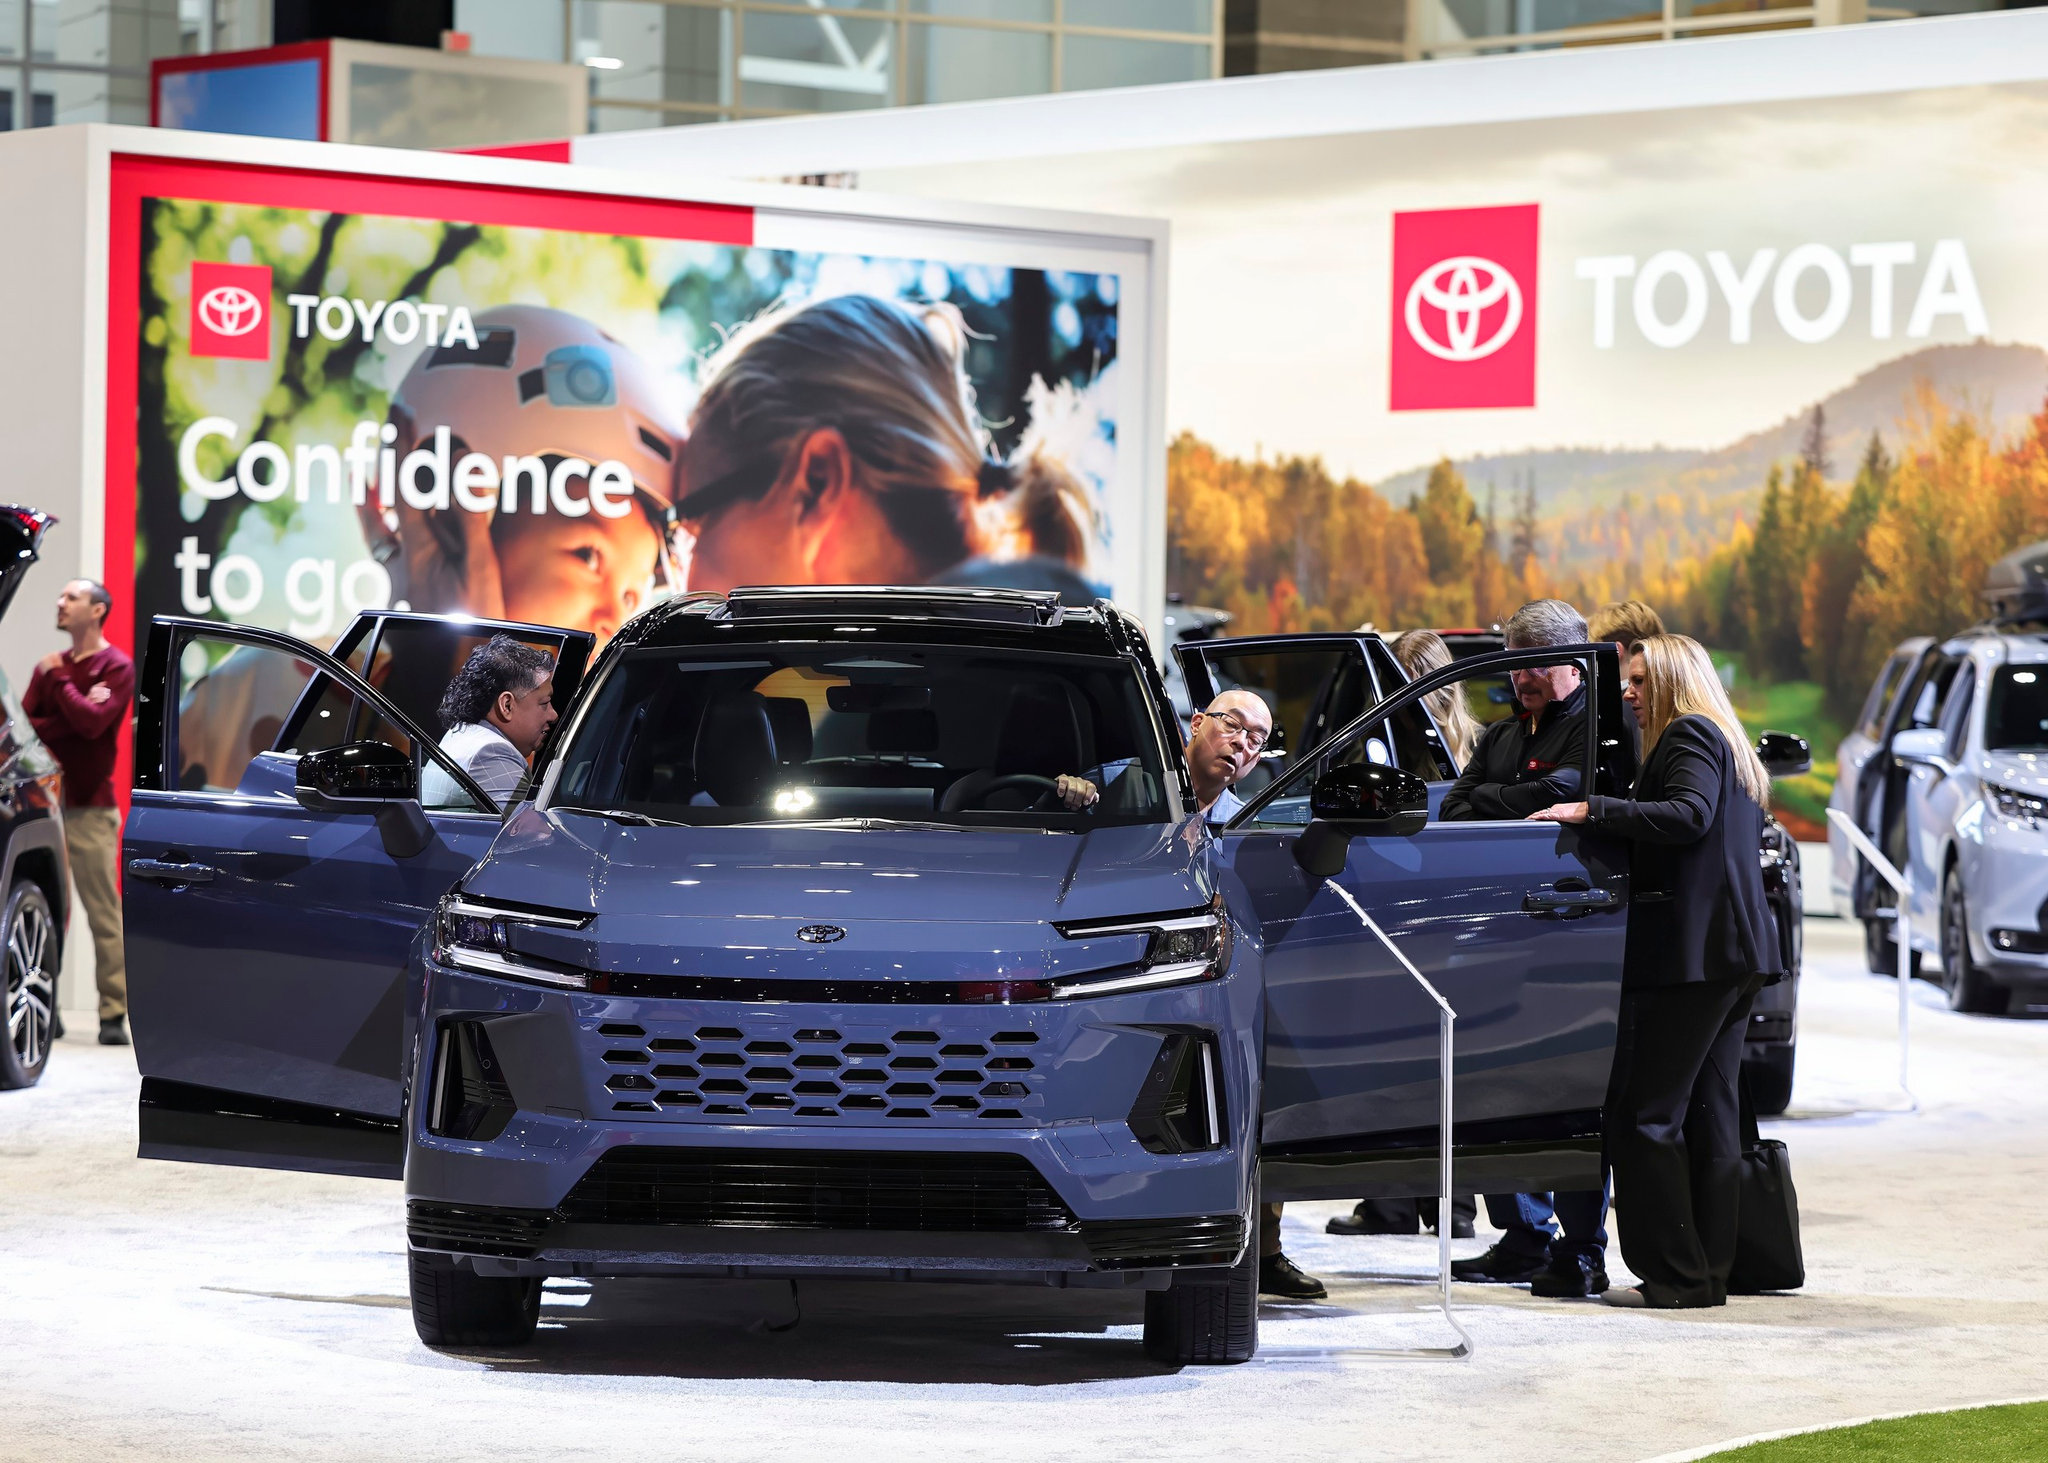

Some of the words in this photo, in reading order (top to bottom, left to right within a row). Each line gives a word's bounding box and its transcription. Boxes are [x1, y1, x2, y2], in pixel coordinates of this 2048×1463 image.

[287, 294, 480, 350] TOYOTA
[1575, 239, 1990, 349] TOYOTA
[178, 416, 635, 519] Confidence
[174, 536, 264, 615] to
[284, 557, 412, 640] go.
